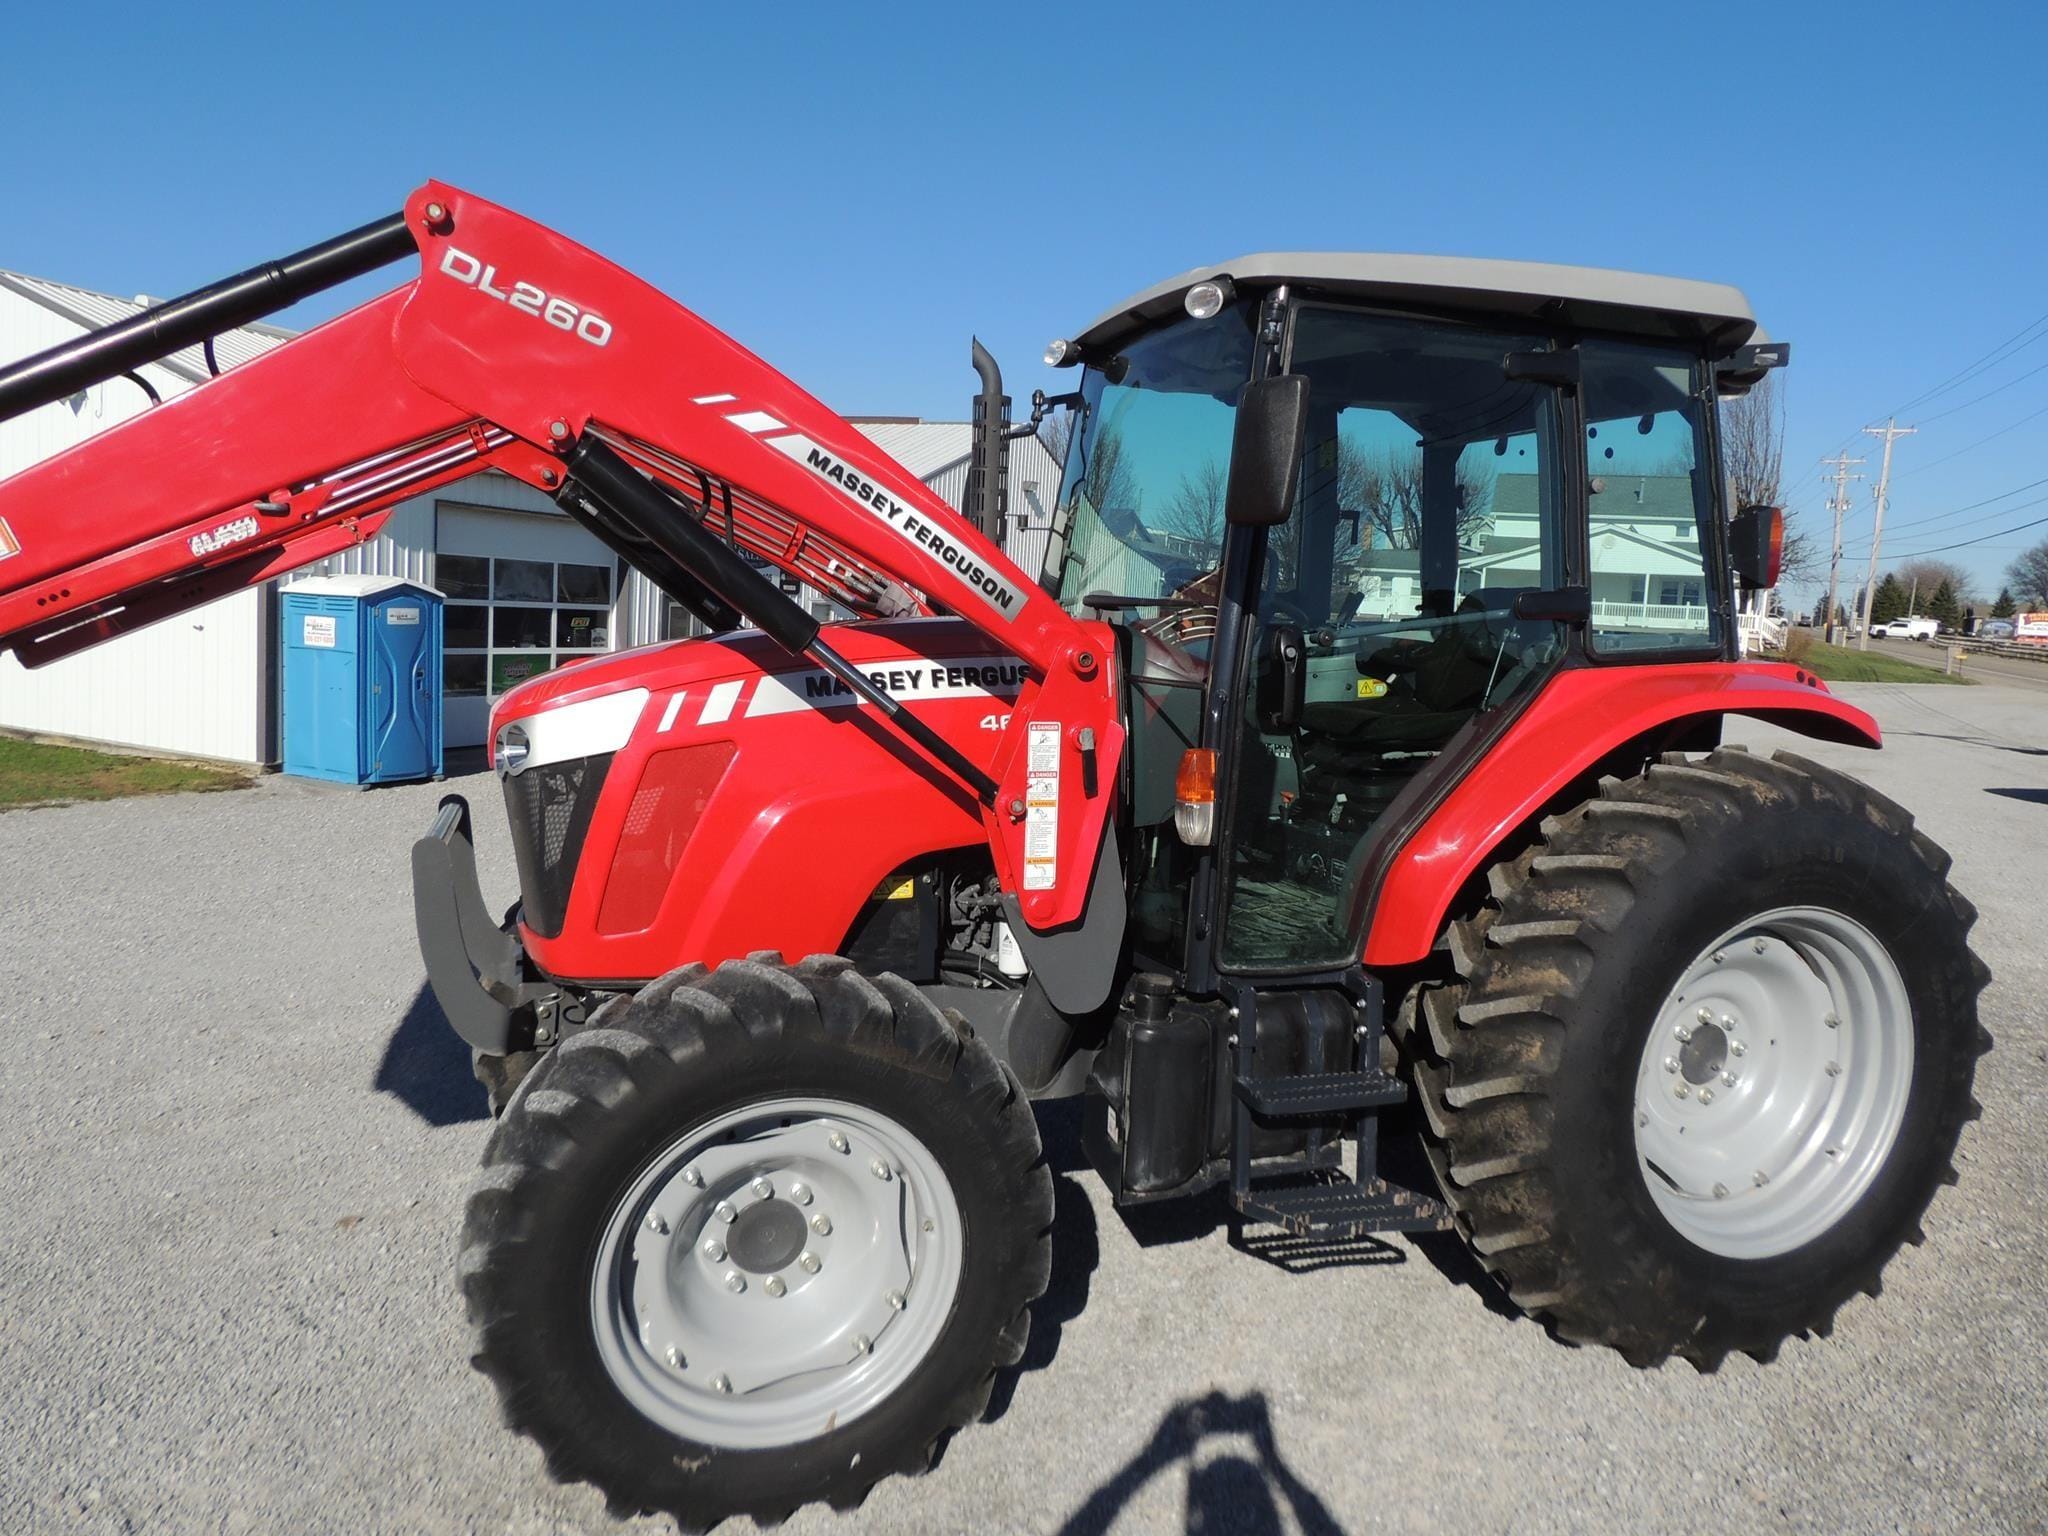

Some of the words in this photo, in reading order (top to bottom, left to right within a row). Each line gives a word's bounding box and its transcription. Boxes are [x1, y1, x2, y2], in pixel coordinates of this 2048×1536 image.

[439, 245, 613, 347] DL260
[806, 447, 904, 520] MASSEY
[902, 515, 1014, 610] FERGUSON
[805, 669, 924, 698] MASEY
[930, 664, 1031, 690] FERGUS
